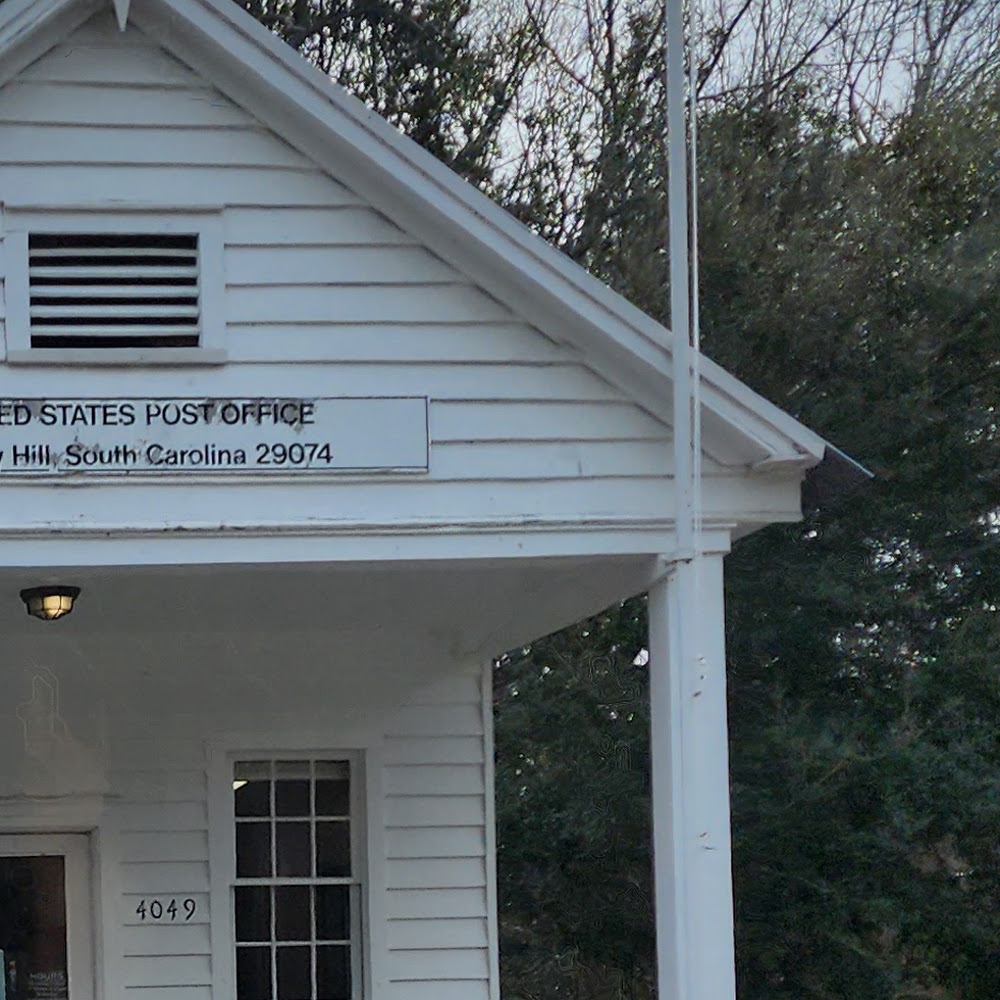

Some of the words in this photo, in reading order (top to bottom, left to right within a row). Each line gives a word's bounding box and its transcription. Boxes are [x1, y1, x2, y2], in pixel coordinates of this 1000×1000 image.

[40, 404, 136, 426] STATES
[145, 403, 214, 425] POST
[221, 403, 316, 425] OFFICE
[65, 444, 137, 466] South
[146, 443, 246, 465] Carolina
[255, 443, 334, 465] 29074
[135, 898, 196, 921] 4049
